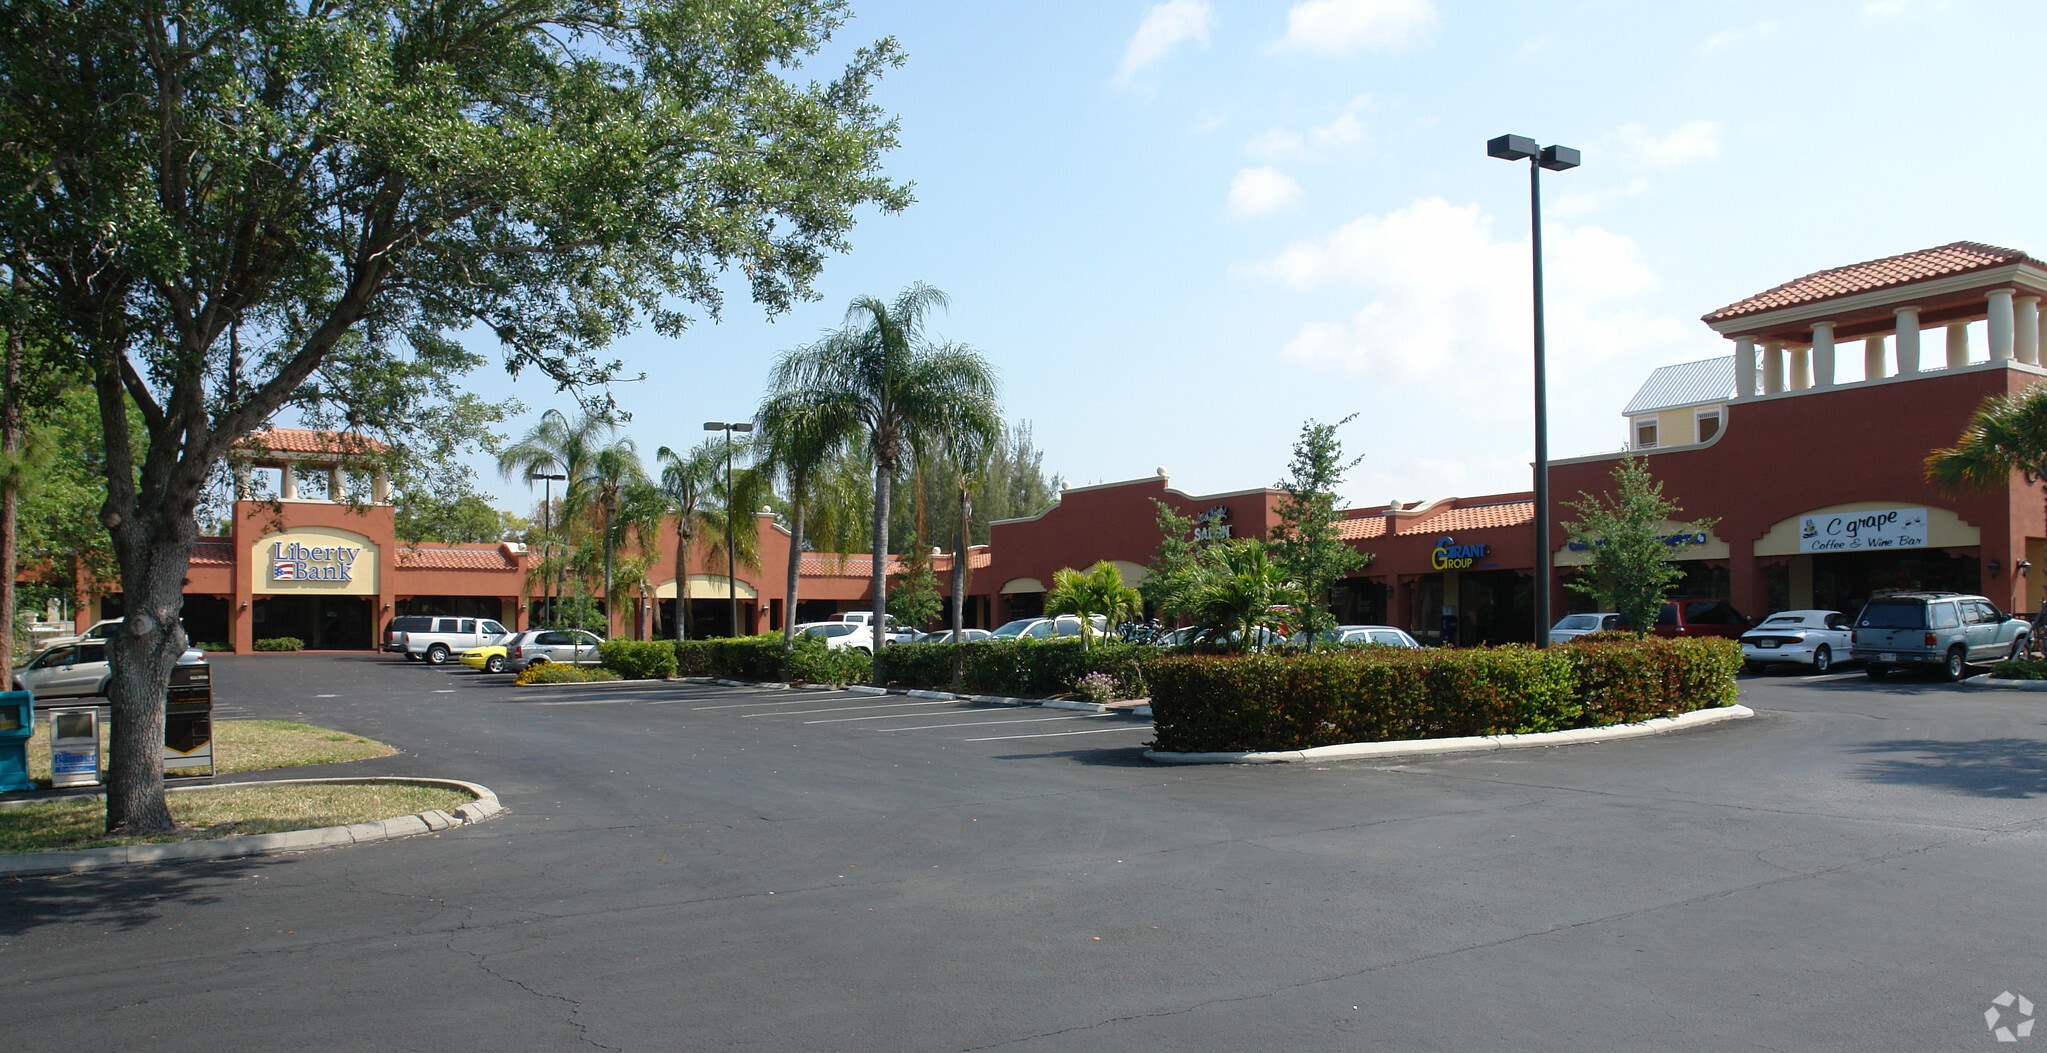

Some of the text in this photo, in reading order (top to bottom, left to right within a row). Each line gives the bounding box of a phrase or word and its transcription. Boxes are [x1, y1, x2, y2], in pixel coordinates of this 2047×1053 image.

[1826, 511, 1898, 538] C grape
[274, 541, 360, 566] Liberty
[1436, 536, 1486, 559] GRANT
[1811, 535, 1922, 551] Coffee & Wine Bar
[1431, 547, 1473, 570] GROUP
[294, 561, 353, 581] Bank
